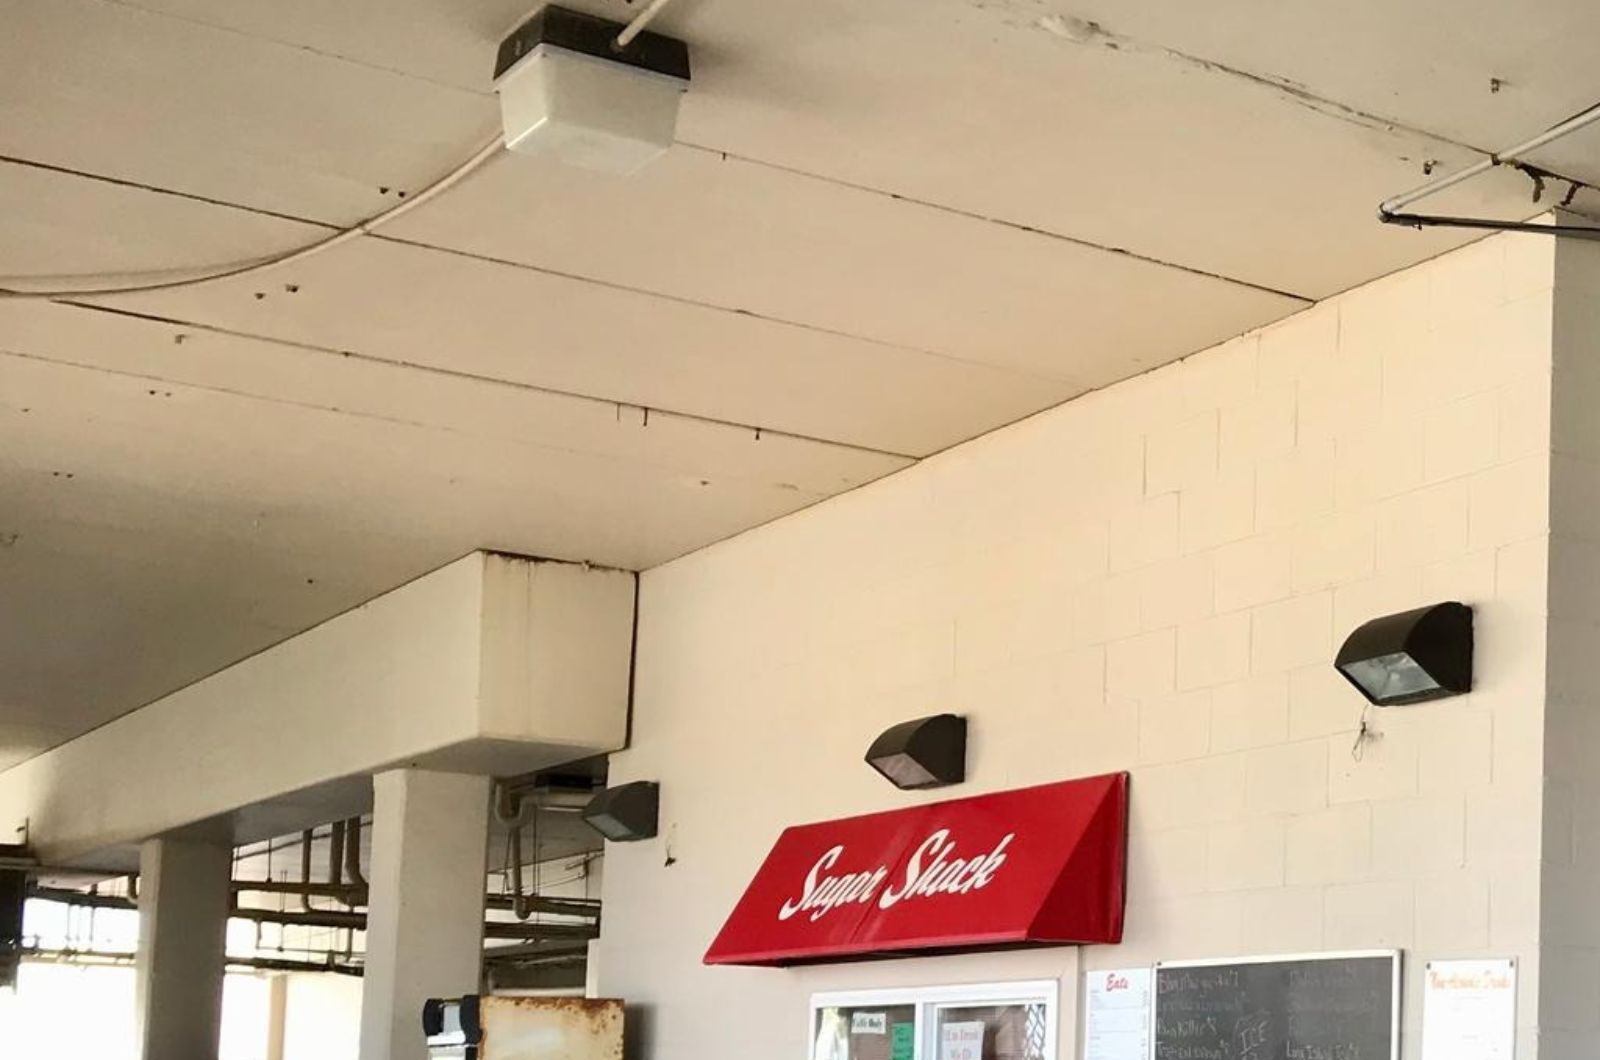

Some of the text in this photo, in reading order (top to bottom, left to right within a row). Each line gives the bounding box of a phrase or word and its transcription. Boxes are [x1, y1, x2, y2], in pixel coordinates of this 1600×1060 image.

[778, 828, 1015, 922] Sugar Shack
[1106, 973, 1129, 992] Eats
